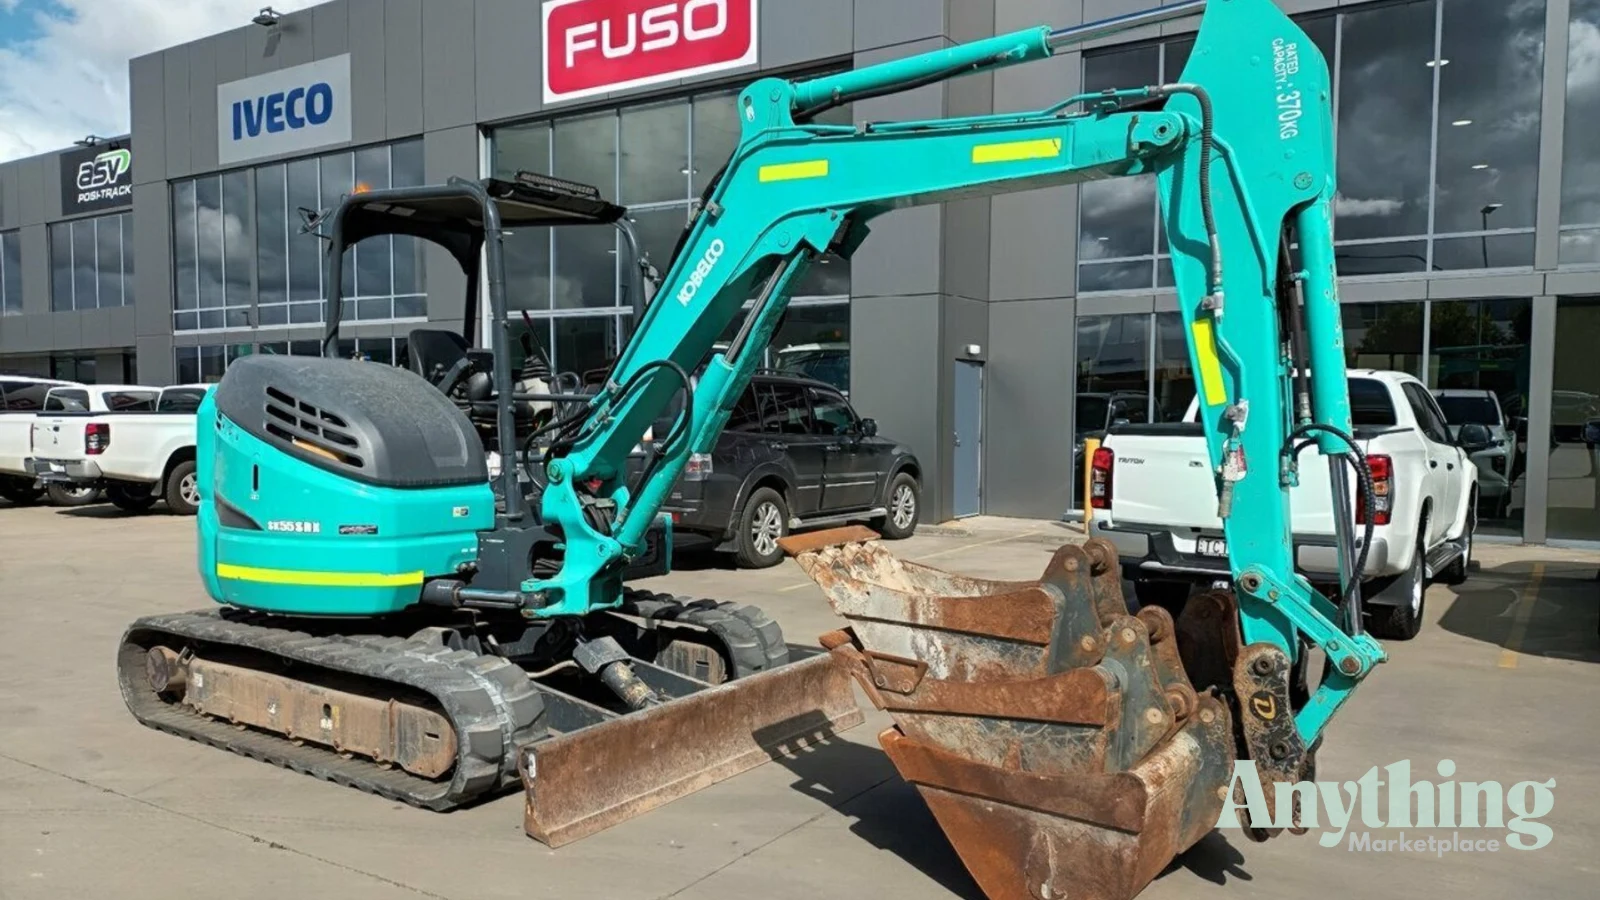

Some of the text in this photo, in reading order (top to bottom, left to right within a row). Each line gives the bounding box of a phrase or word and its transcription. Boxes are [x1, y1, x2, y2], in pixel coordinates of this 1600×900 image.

[565, 0, 728, 69] FUSO
[1285, 42, 1299, 75] RATED
[232, 82, 333, 141] IVECO
[1276, 90, 1303, 140] 370KG
[77, 184, 132, 203] POSI-TRACK
[676, 238, 725, 307] KOBELCO
[1118, 457, 1145, 465] TRITON
